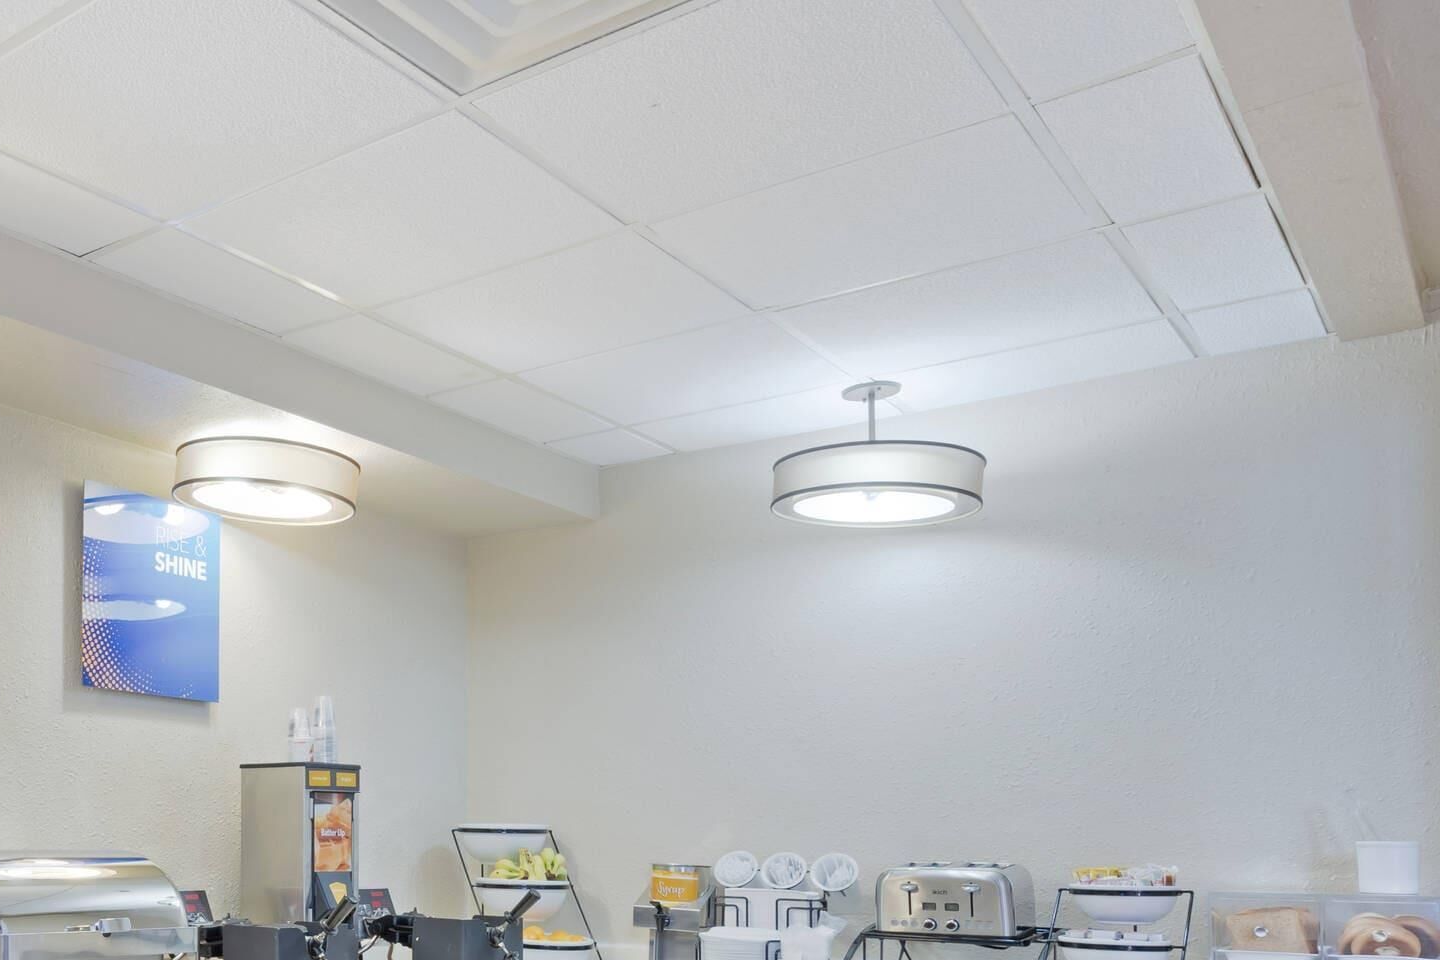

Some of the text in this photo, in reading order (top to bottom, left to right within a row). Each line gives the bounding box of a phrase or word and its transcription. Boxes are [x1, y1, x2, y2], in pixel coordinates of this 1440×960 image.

[155, 527, 207, 557] RISE &
[154, 551, 208, 581] SHINE
[656, 880, 685, 898] Syrup
